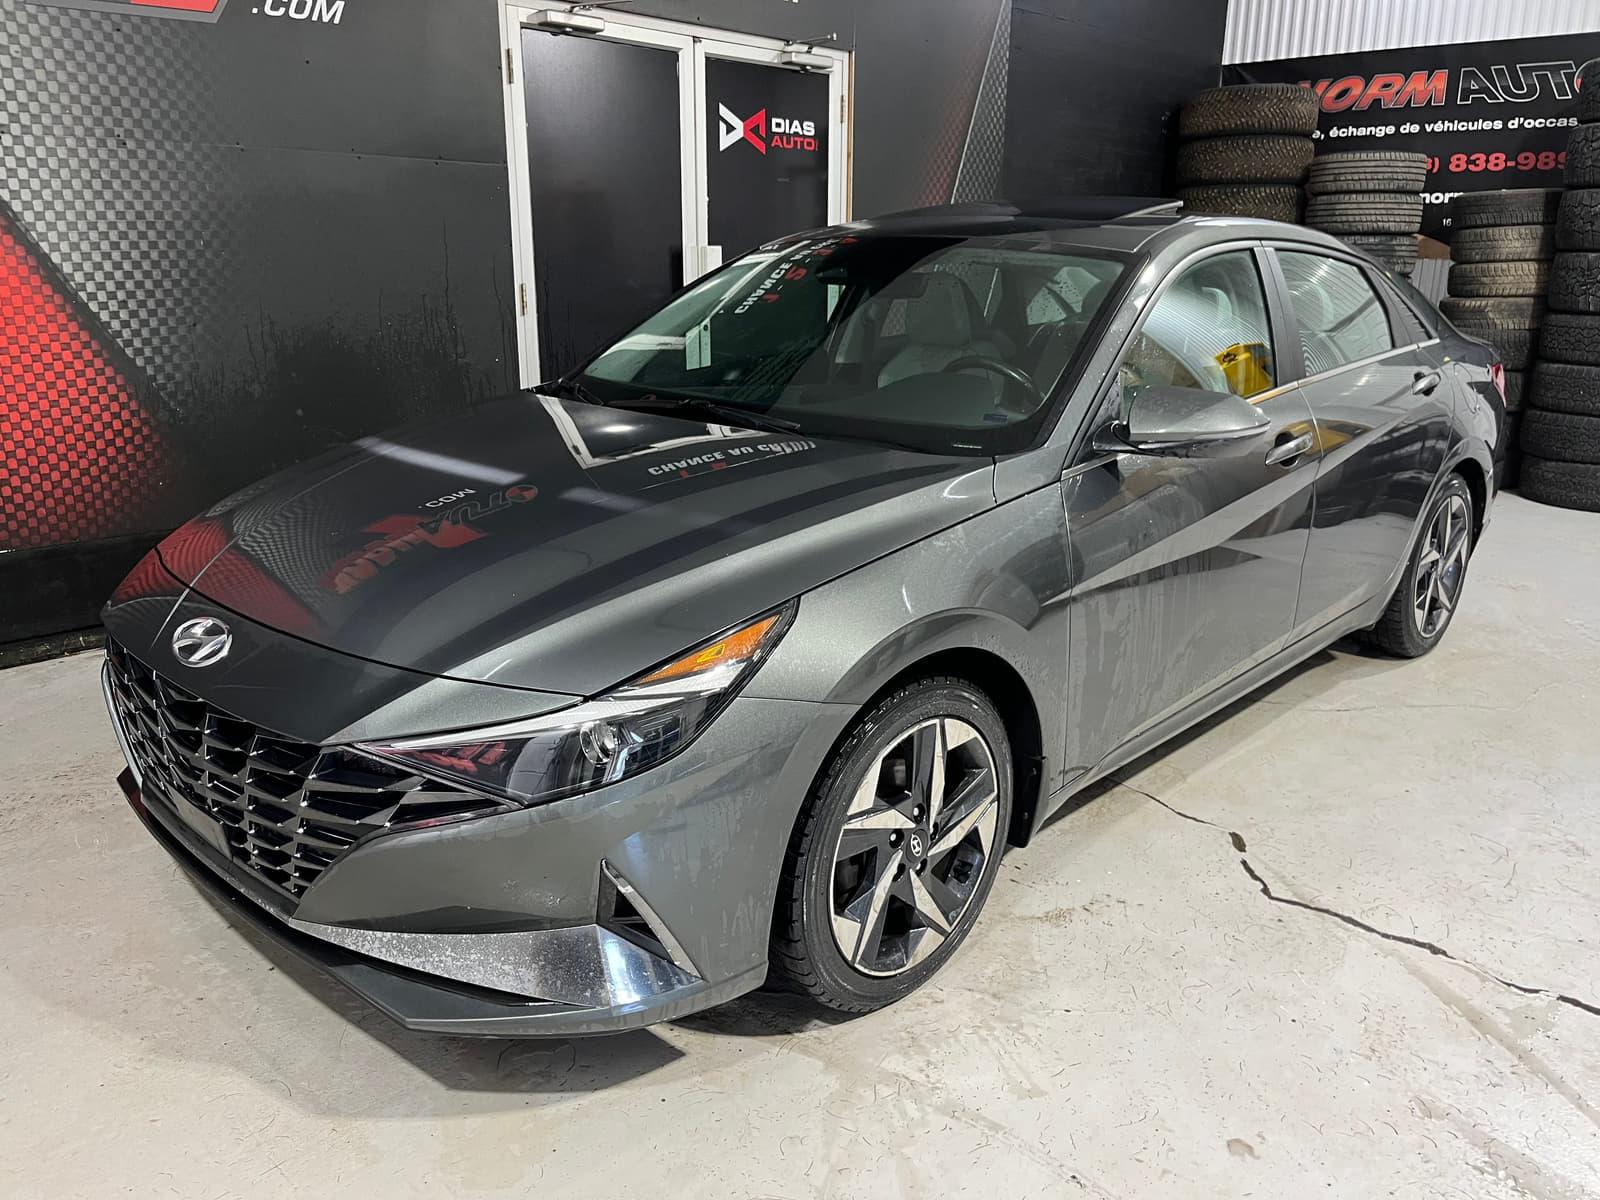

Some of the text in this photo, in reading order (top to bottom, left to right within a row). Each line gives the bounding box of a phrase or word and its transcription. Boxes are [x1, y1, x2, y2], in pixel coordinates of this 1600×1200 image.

[252, 0, 345, 24] .COM
[771, 117, 816, 136] DIAS
[1329, 126, 1395, 137] échange
[1400, 122, 1420, 134] de
[1424, 119, 1503, 133] véhicules
[771, 135, 816, 151] AUTO
